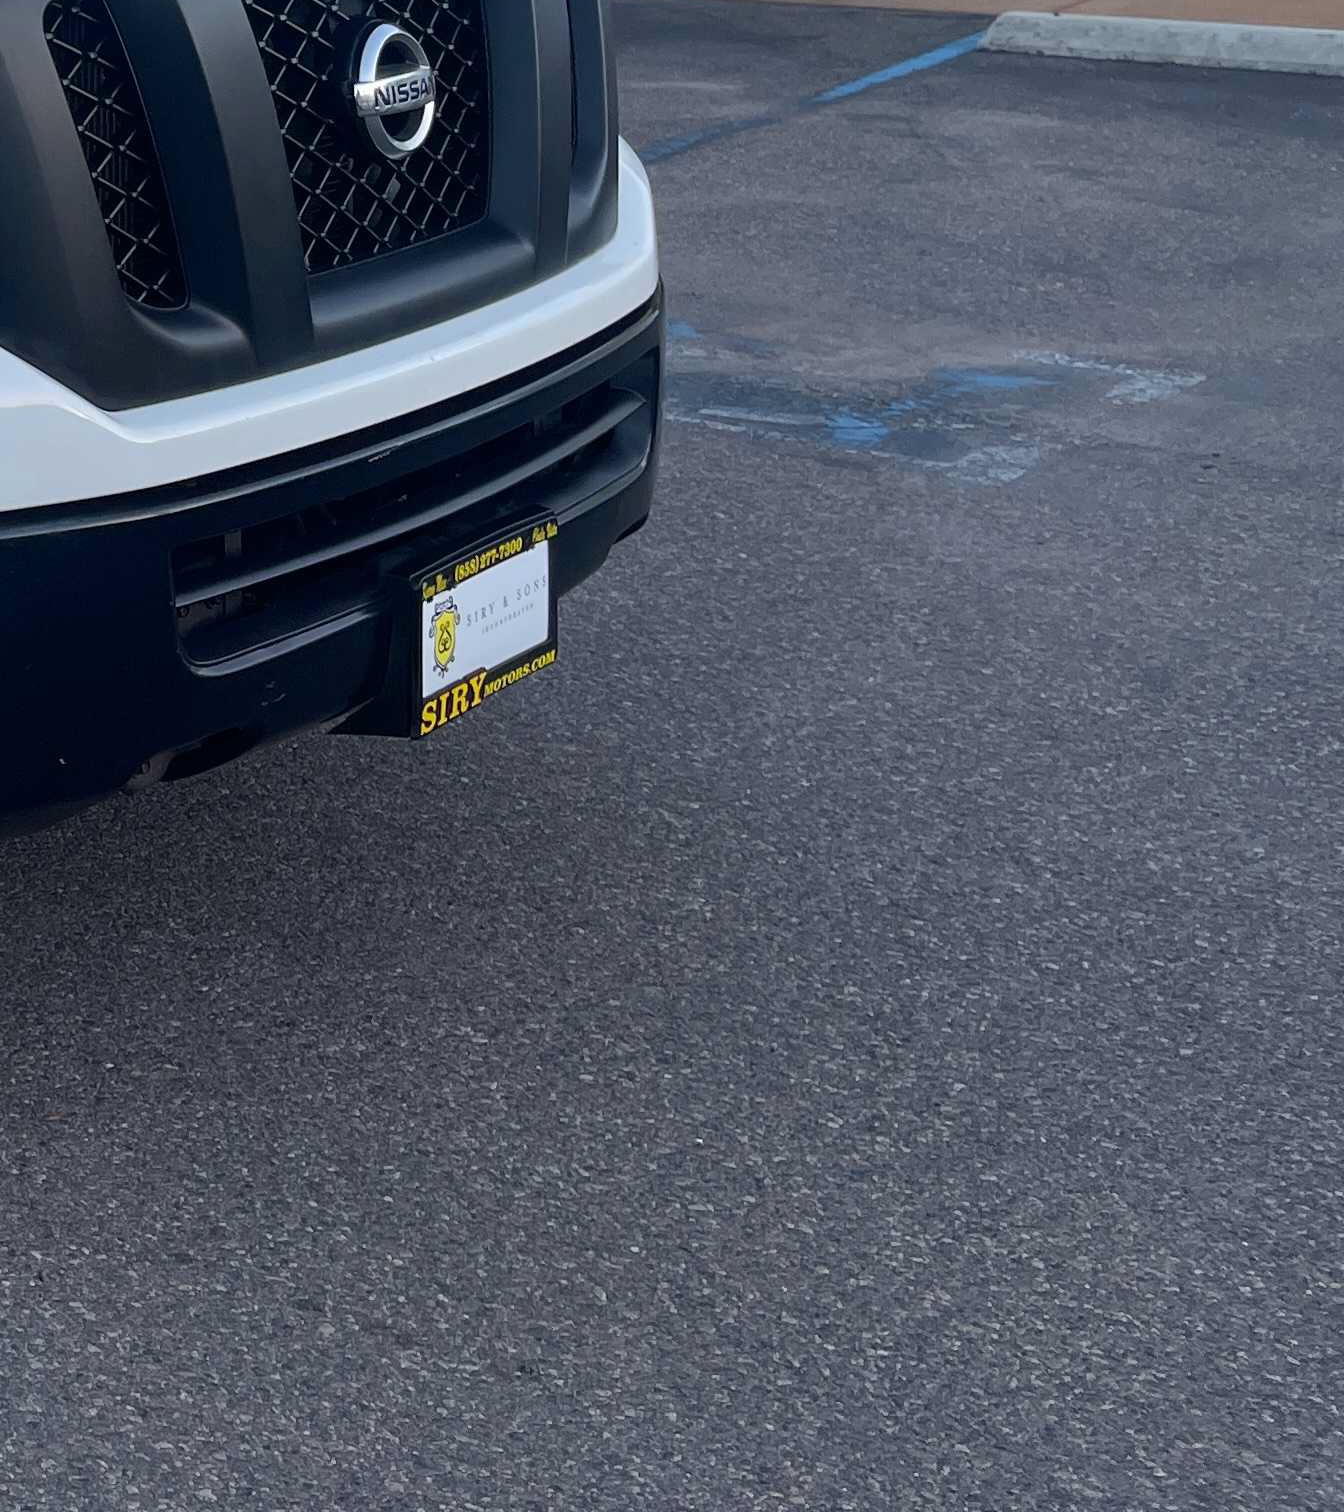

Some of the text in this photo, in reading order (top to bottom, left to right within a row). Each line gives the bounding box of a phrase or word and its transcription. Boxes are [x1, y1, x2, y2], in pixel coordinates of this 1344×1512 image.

[374, 77, 434, 108] NISSA
[465, 601, 496, 627] SIRY
[420, 670, 488, 737] SIRY
